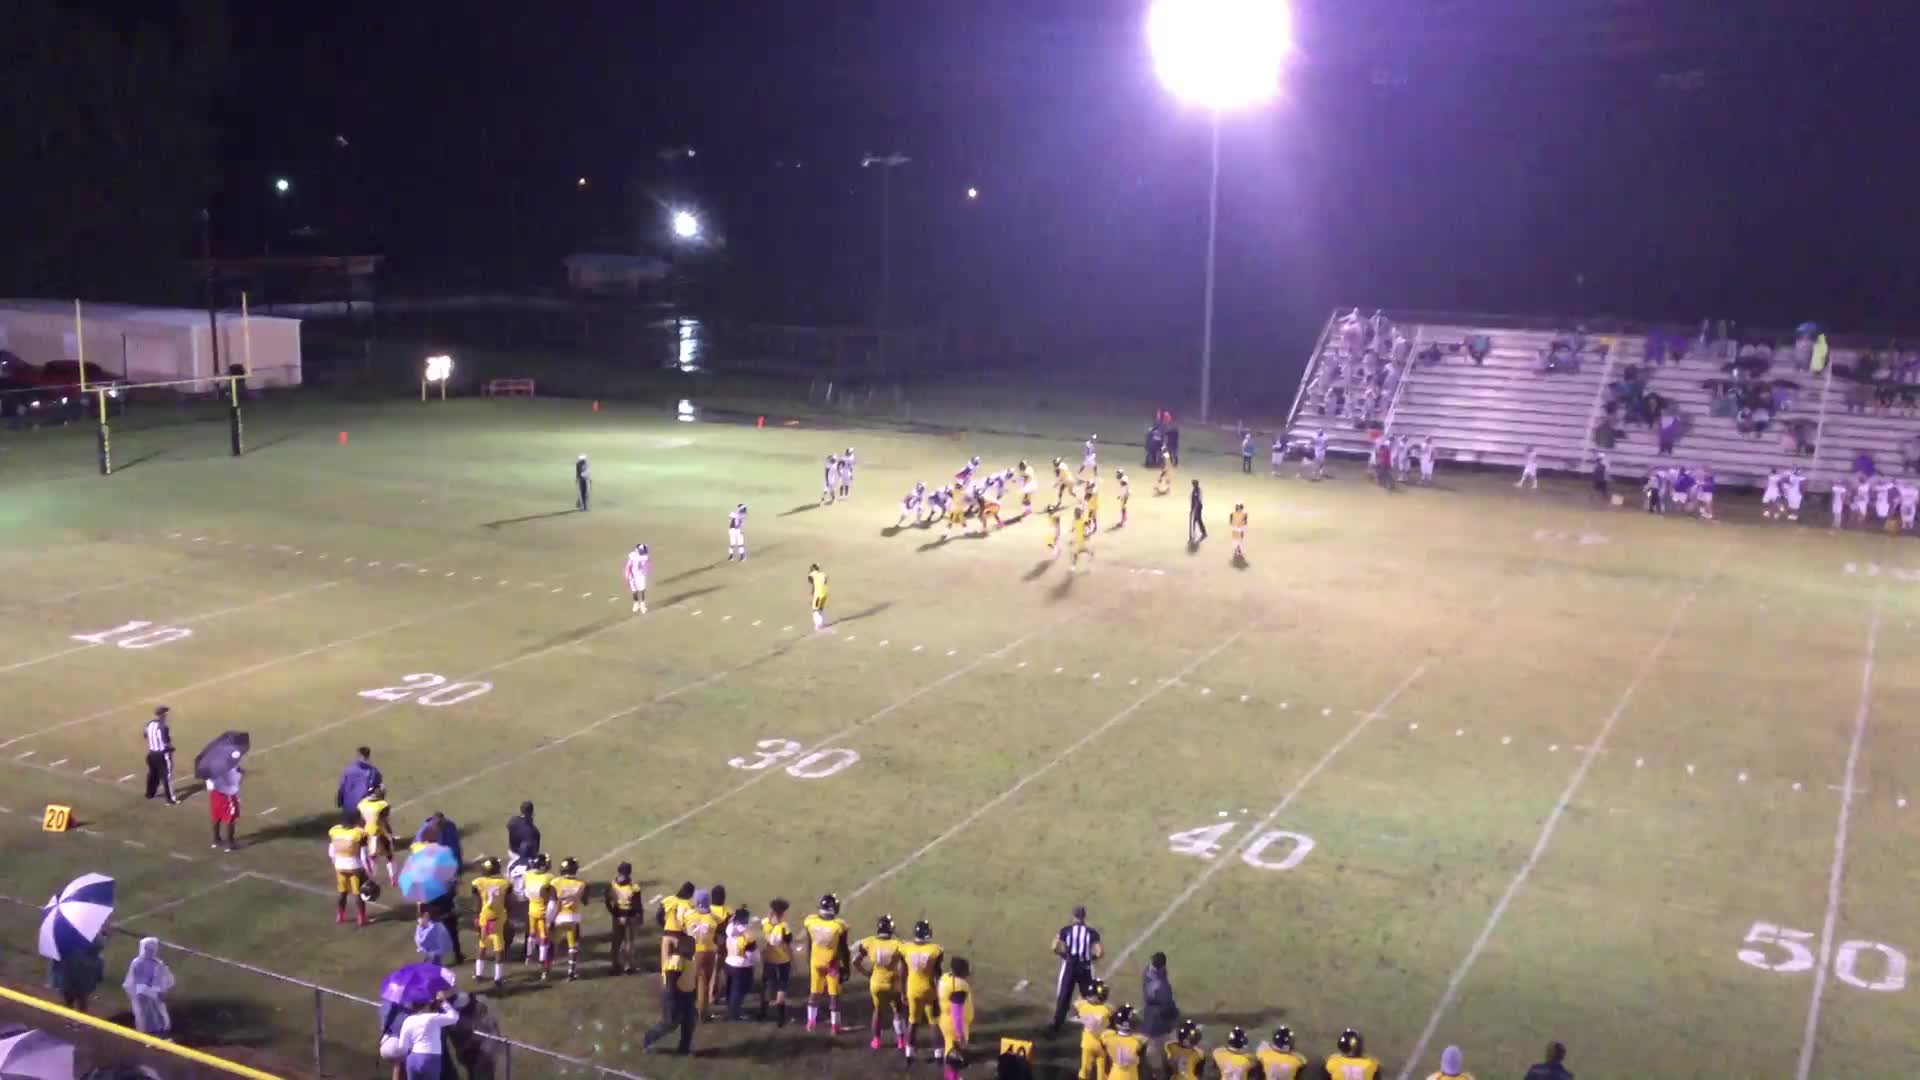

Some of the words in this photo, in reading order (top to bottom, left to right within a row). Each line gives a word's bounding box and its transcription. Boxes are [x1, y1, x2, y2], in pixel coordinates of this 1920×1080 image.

[70, 620, 192, 649] 10
[356, 672, 493, 706] 20
[727, 738, 860, 779] 30
[46, 808, 65, 829] 20
[1168, 822, 1316, 870] 40
[1736, 921, 1907, 991] 50
